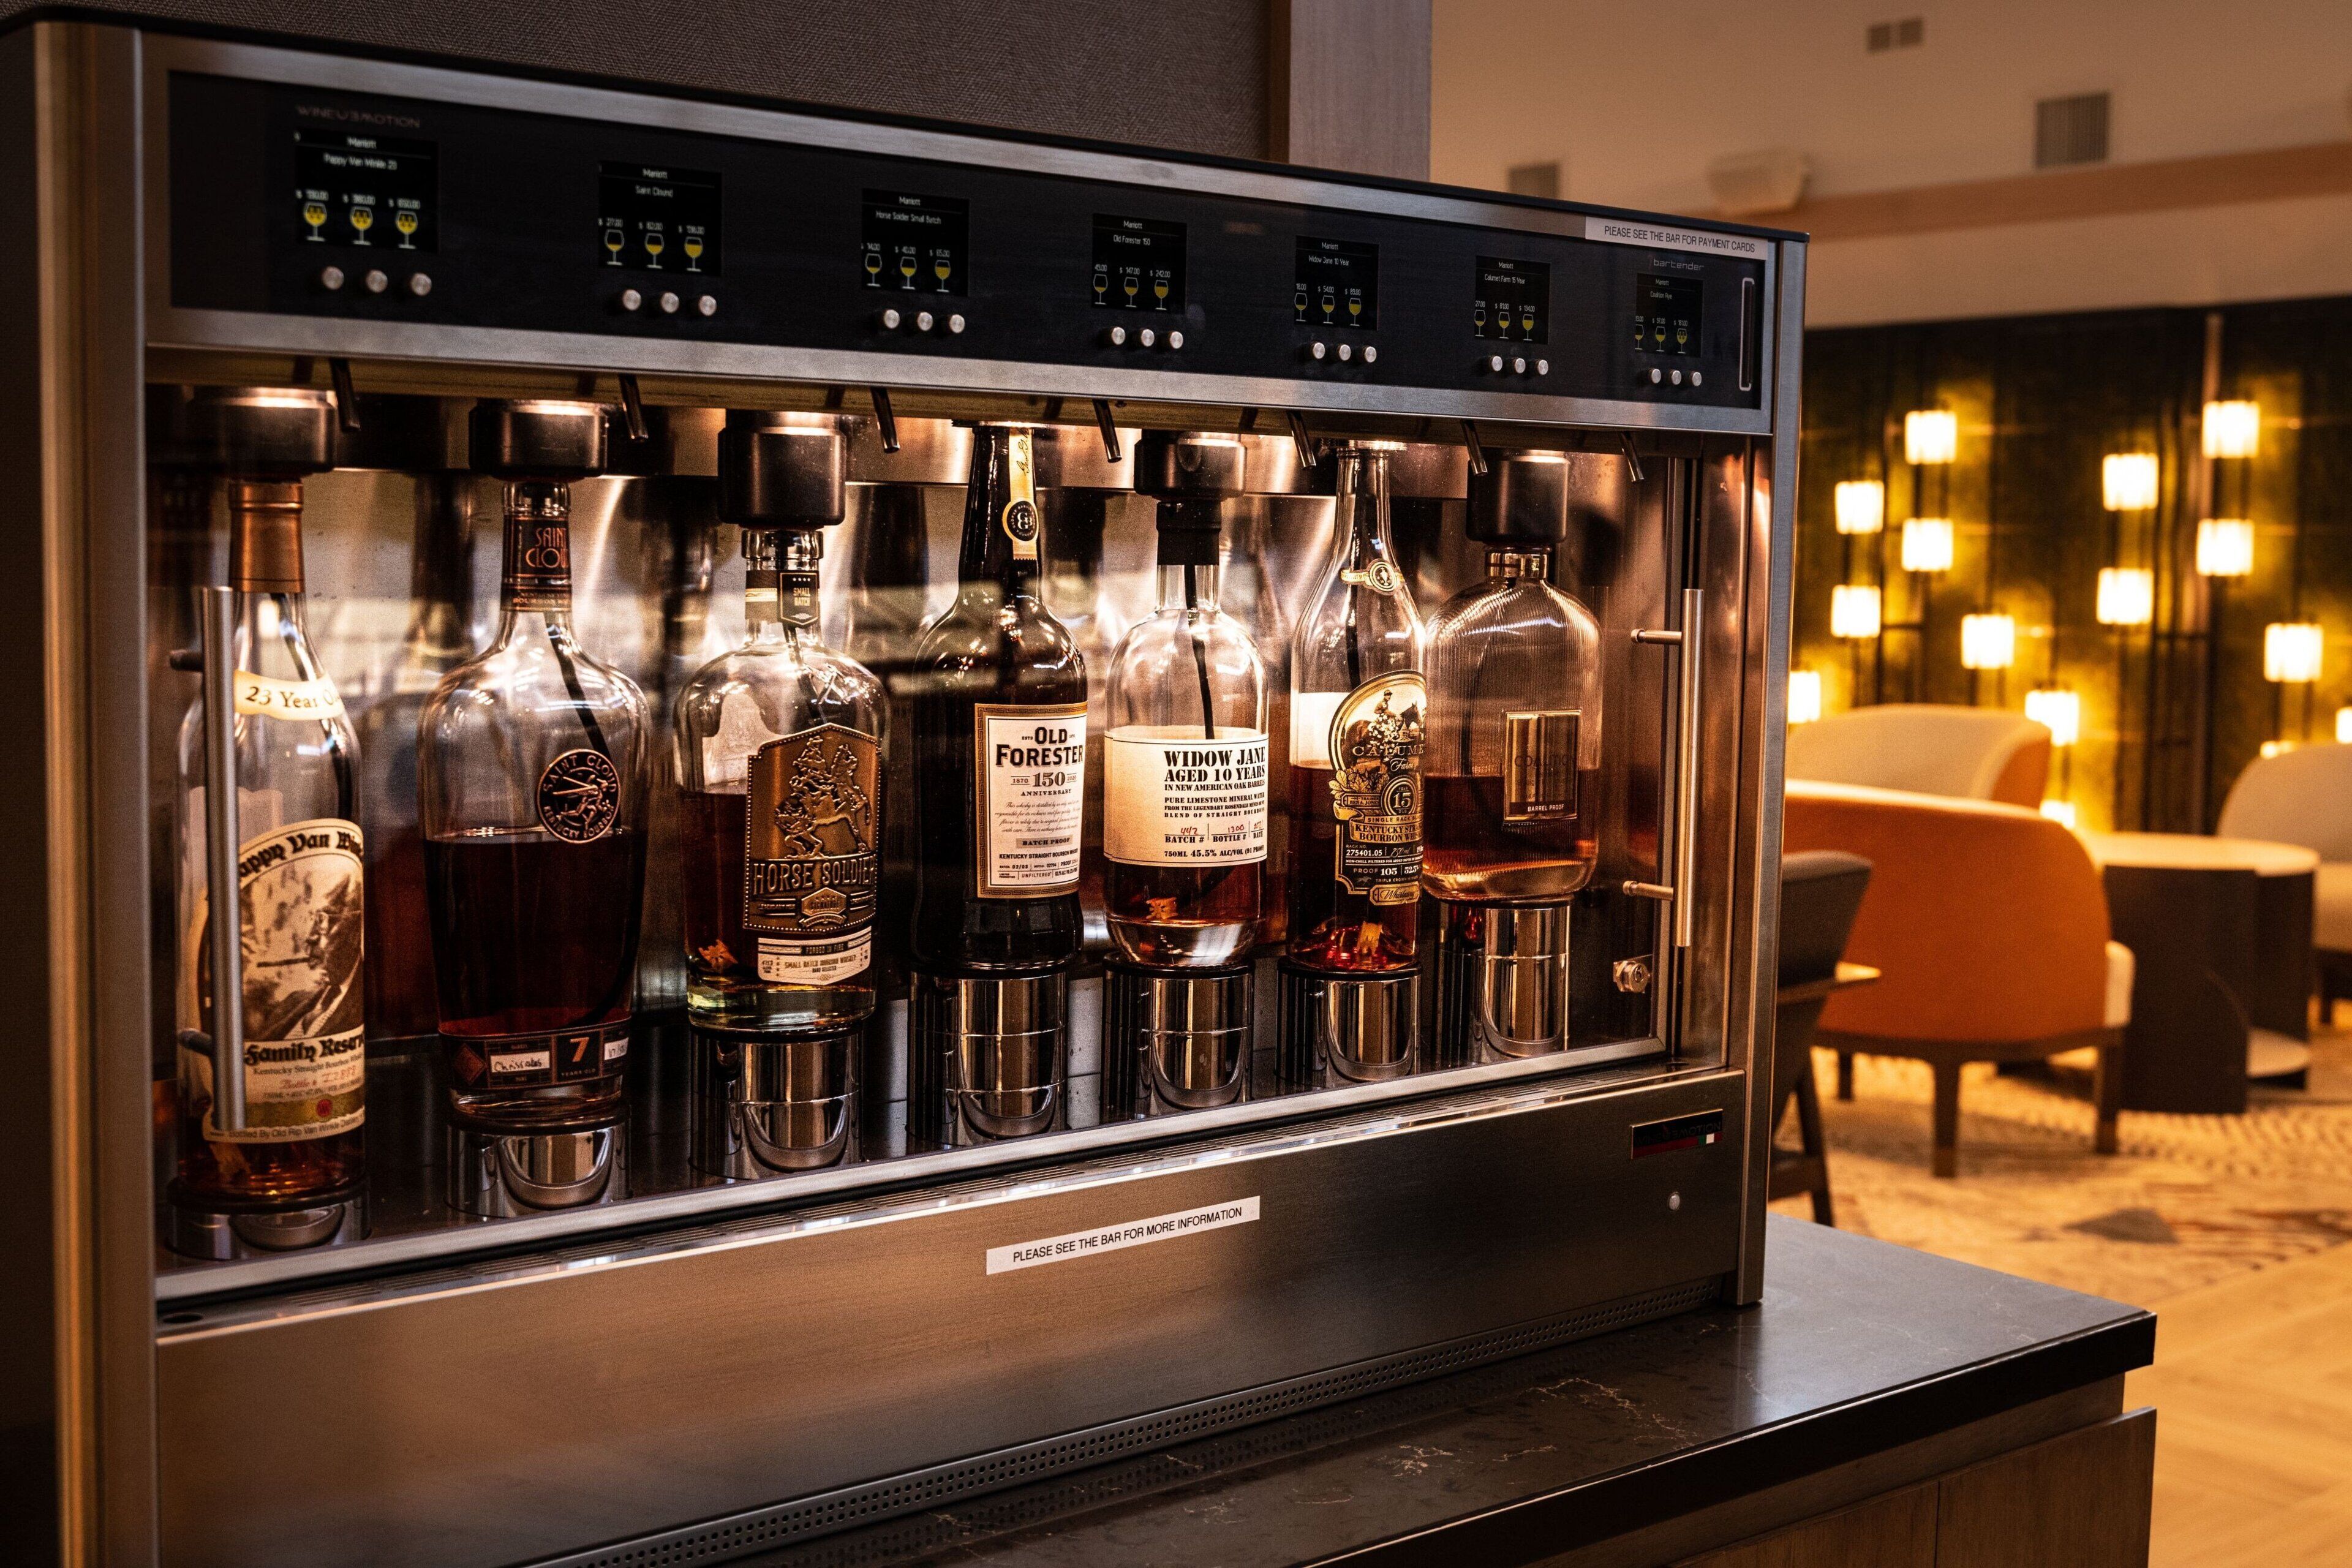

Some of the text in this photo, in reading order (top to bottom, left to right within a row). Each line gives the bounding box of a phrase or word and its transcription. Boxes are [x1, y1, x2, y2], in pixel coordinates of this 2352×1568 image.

[1123, 220, 1143, 230] Marriott
[1113, 234, 1151, 246] Old Forester 150
[1321, 241, 1339, 251] Marriott
[1604, 225, 1755, 253] PLEASE SEE THE BAR FOR PAYMENT CARDS
[1308, 255, 1322, 263] Widow
[1322, 256, 1333, 265] Jane
[1498, 261, 1514, 270] Marriott
[1653, 258, 1705, 271] bartender
[1484, 273, 1501, 282] Calumet
[1501, 275, 1511, 284] Farm
[535, 527, 567, 548] SAINT
[245, 685, 272, 706] 23
[279, 690, 318, 709] Year
[1035, 726, 1068, 745] OLD
[996, 744, 1084, 767] FORESTER
[1164, 747, 1265, 767] WIDOW JANE
[1352, 744, 1425, 756] CALUME
[1389, 757, 1414, 772] Farm
[543, 755, 617, 793] SAINT CLOUD
[1032, 771, 1066, 788] 150
[1164, 764, 1265, 782] AGED 10 YEARS
[1247, 779, 1265, 788] BARRELS
[1392, 792, 1412, 809] 15
[1243, 807, 1265, 815] BOURBONS
[1227, 824, 1245, 833] 1300
[1253, 831, 1263, 839] DATE
[1355, 824, 1403, 834] KENTUCKY
[285, 832, 331, 854] Van
[1359, 833, 1403, 842] BOURBON
[1219, 848, 1243, 857] ALC/VOL
[1380, 867, 1398, 876] 105
[753, 863, 813, 895] HORSE
[243, 1042, 317, 1066] Family
[569, 1036, 589, 1063] 7
[1012, 1207, 1242, 1263] PLEASE SEE THE BAR FOR MORE INFORMATION
